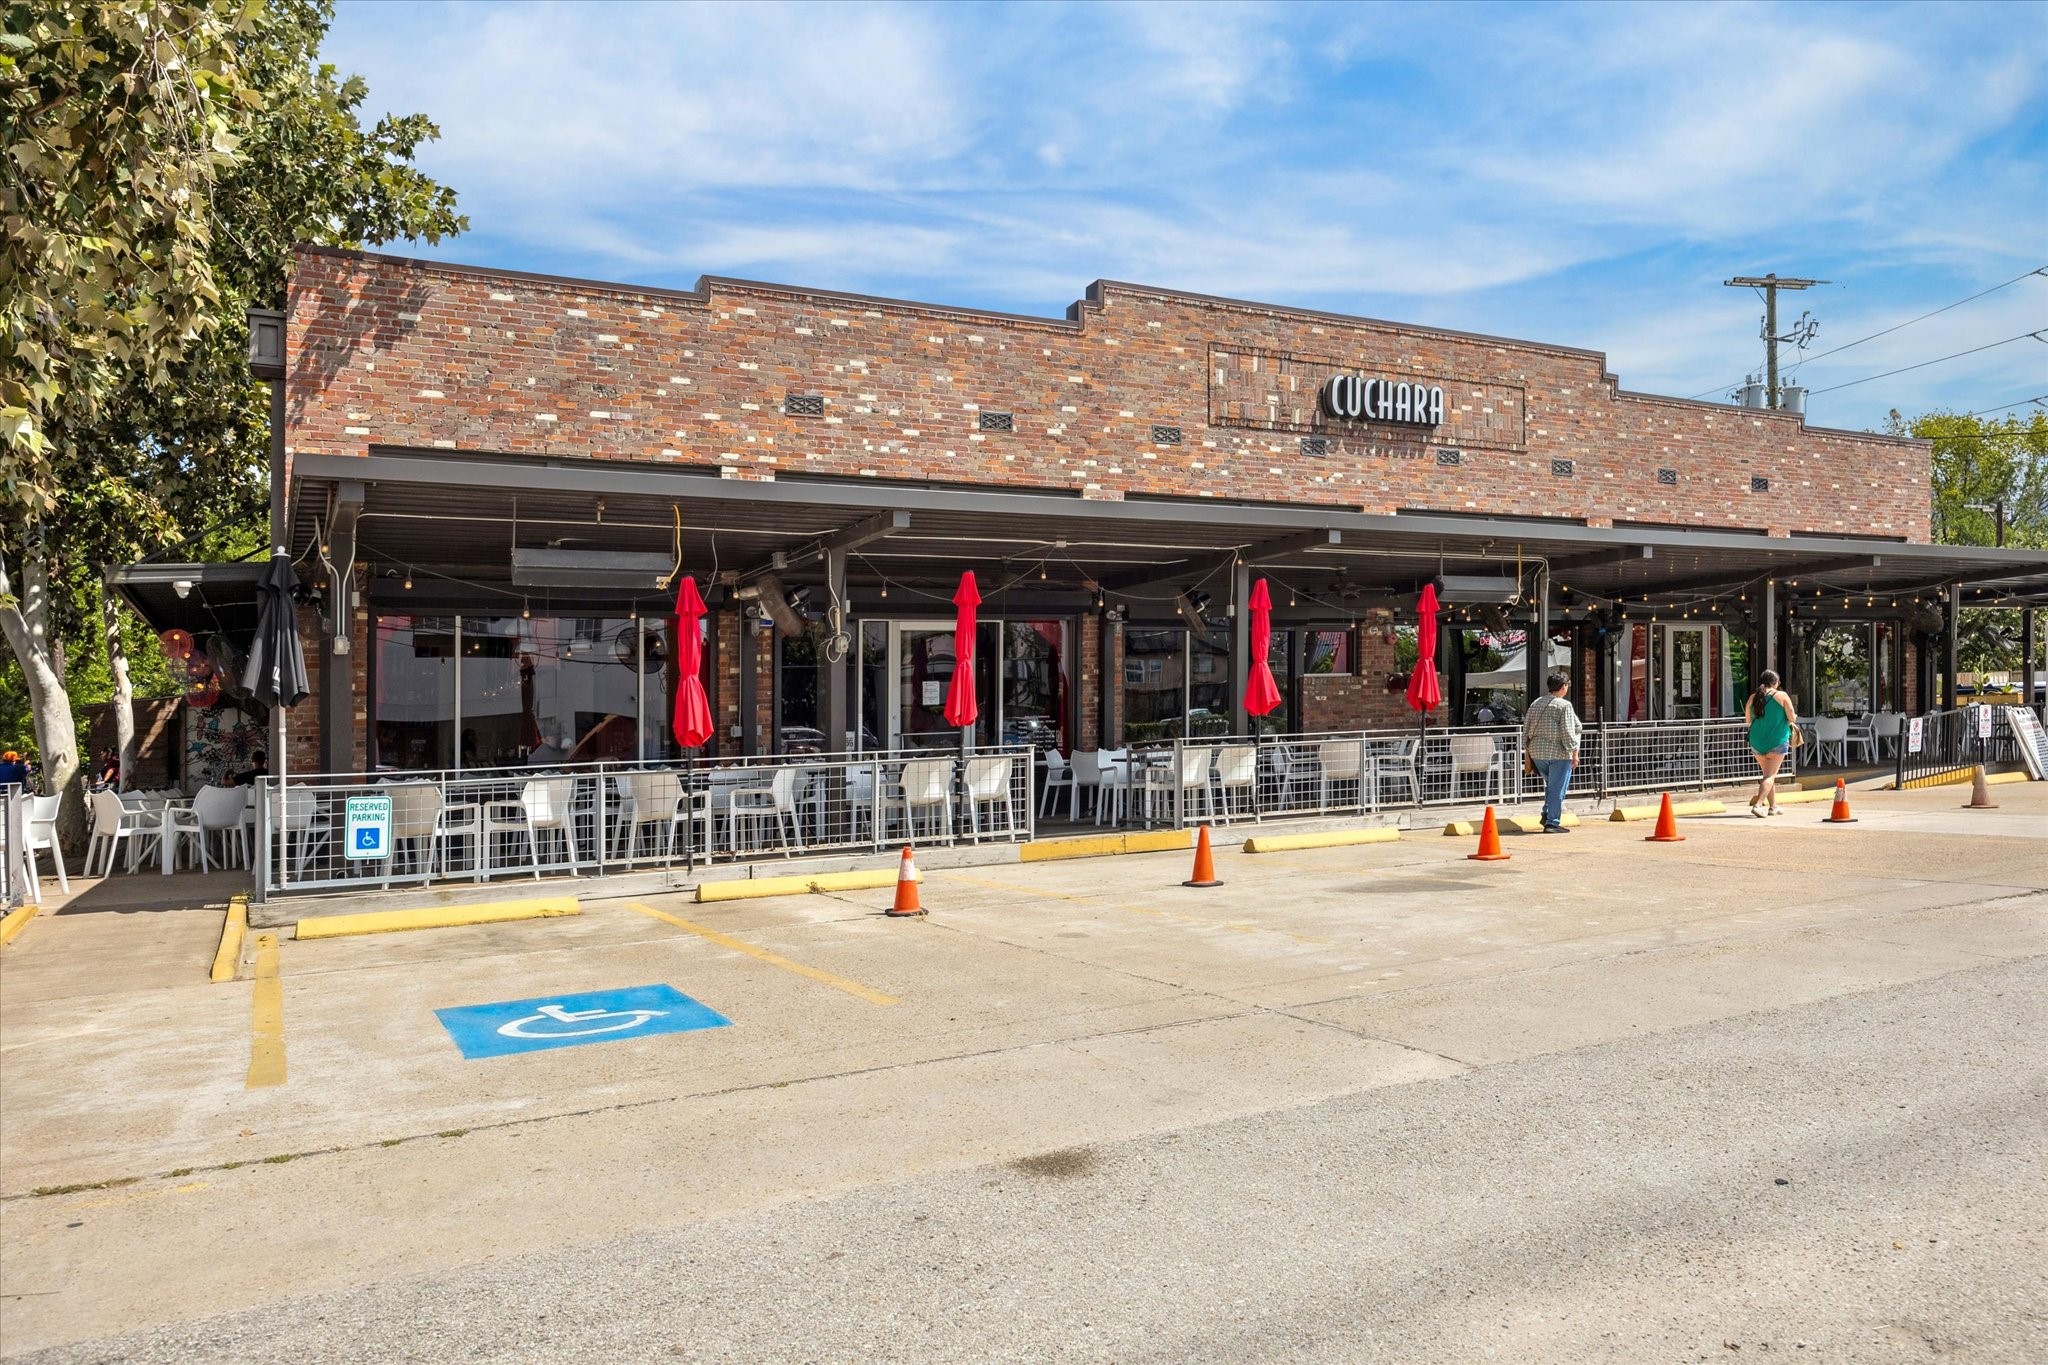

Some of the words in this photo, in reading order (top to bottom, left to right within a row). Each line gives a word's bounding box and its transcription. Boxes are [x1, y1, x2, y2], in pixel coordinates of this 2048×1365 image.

[1332, 375, 1444, 425] CUCHARA
[350, 802, 388, 811] RESERVED
[352, 813, 385, 821] PARKING
